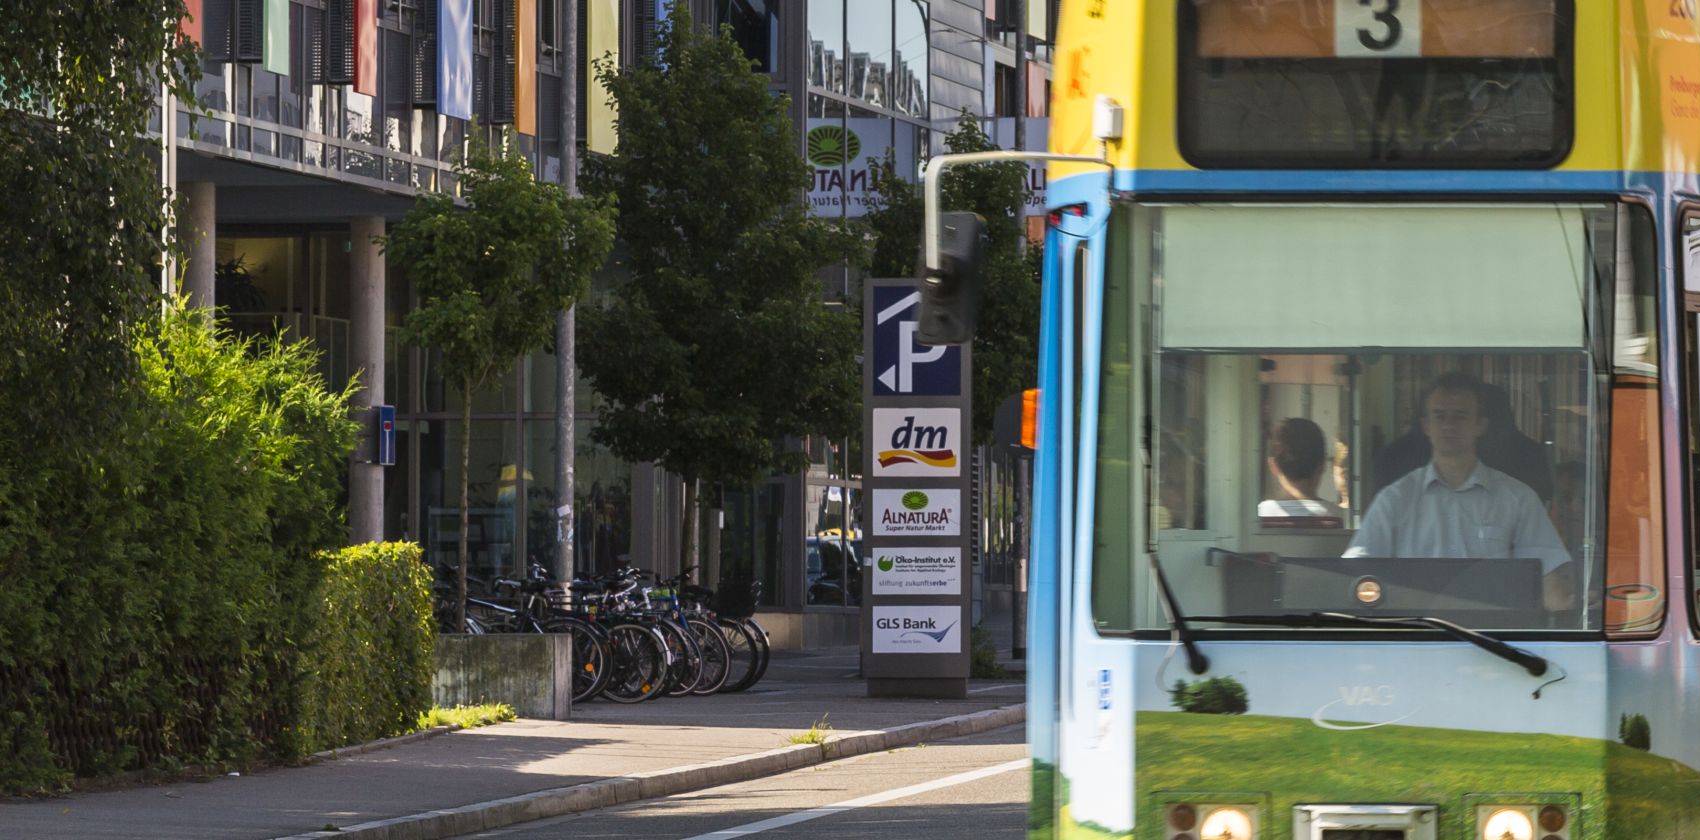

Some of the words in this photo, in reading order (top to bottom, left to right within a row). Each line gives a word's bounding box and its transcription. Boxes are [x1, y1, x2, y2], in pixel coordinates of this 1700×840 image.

[1357, 0, 1402, 51] 3
[891, 416, 948, 450] dm
[895, 555, 941, 564] Öko-Institut
[942, 556, 956, 564] e.V.
[876, 618, 900, 630] GLS
[903, 618, 936, 630] Bank
[1339, 685, 1394, 707] VAG
